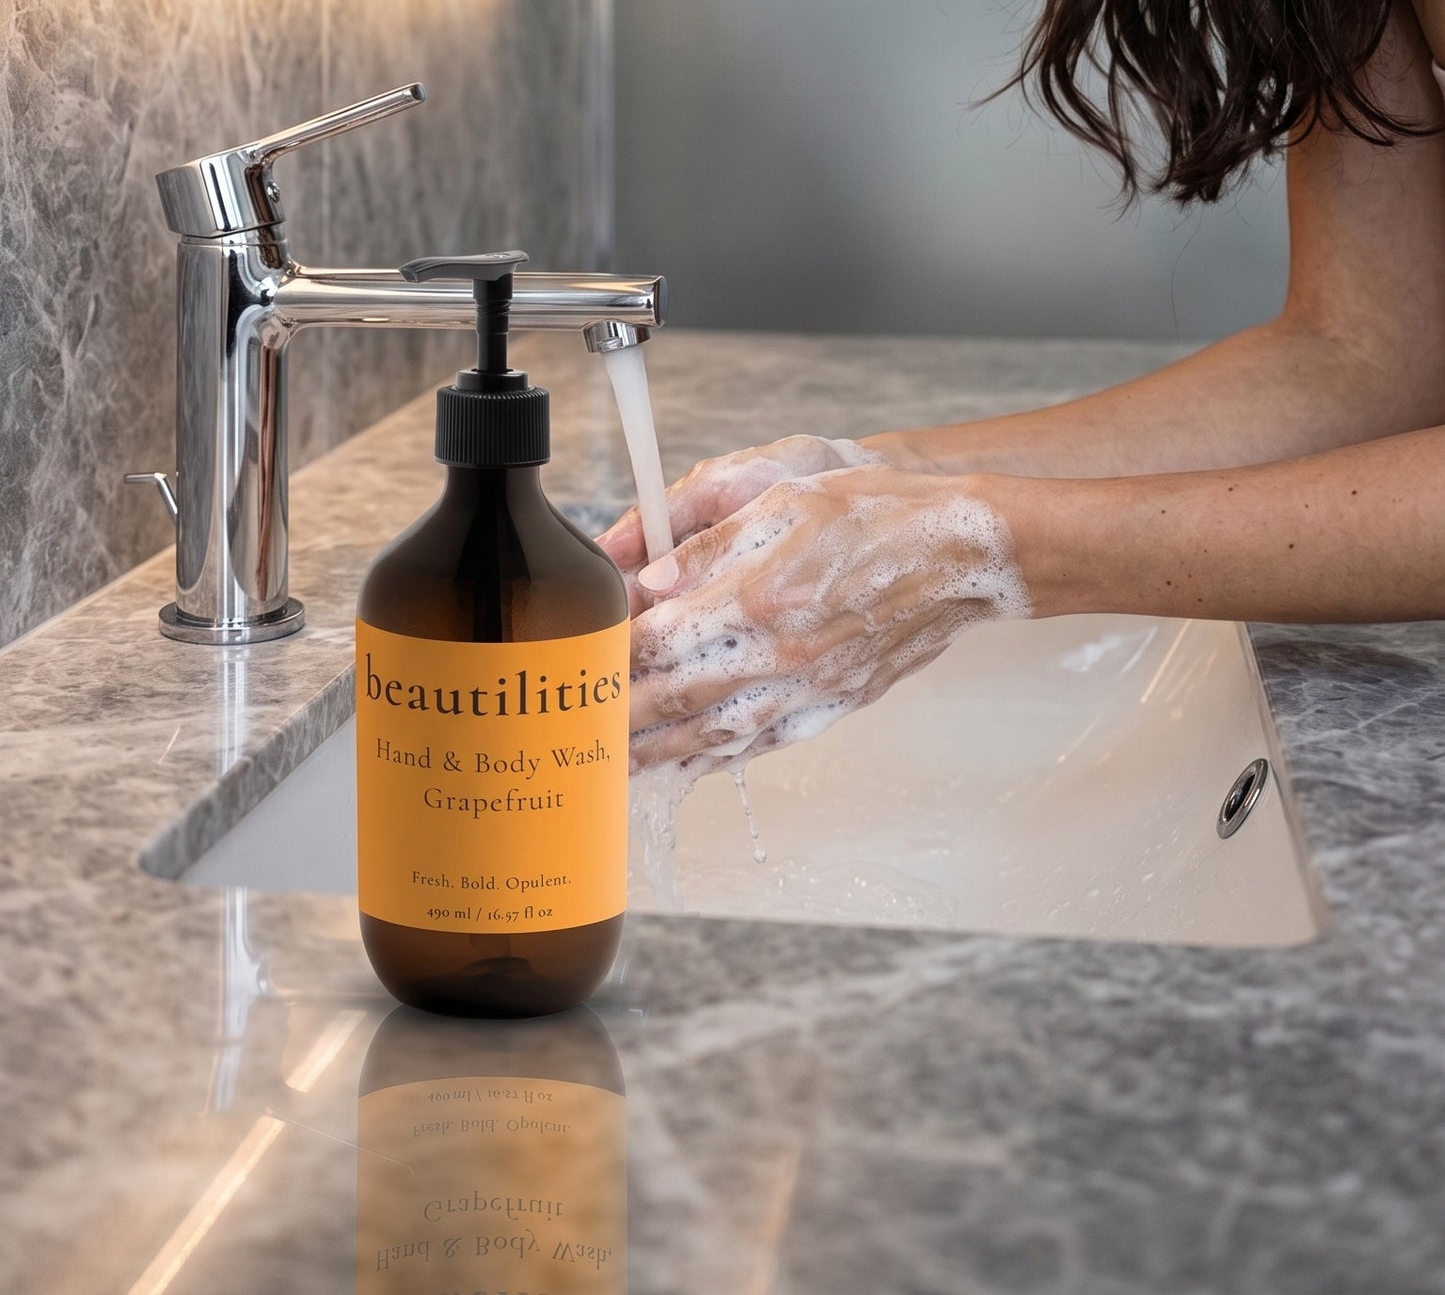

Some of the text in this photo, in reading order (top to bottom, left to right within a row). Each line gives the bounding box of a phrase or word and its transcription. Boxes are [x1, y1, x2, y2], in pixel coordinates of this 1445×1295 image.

[365, 652, 622, 718] beautilities
[376, 737, 611, 781] Hand & Body Wash,
[423, 787, 566, 819] Grapefruit
[412, 870, 572, 894] Fresh. Bold. Opulent.
[426, 905, 554, 923] 490 ml / 16.57 fl oz
